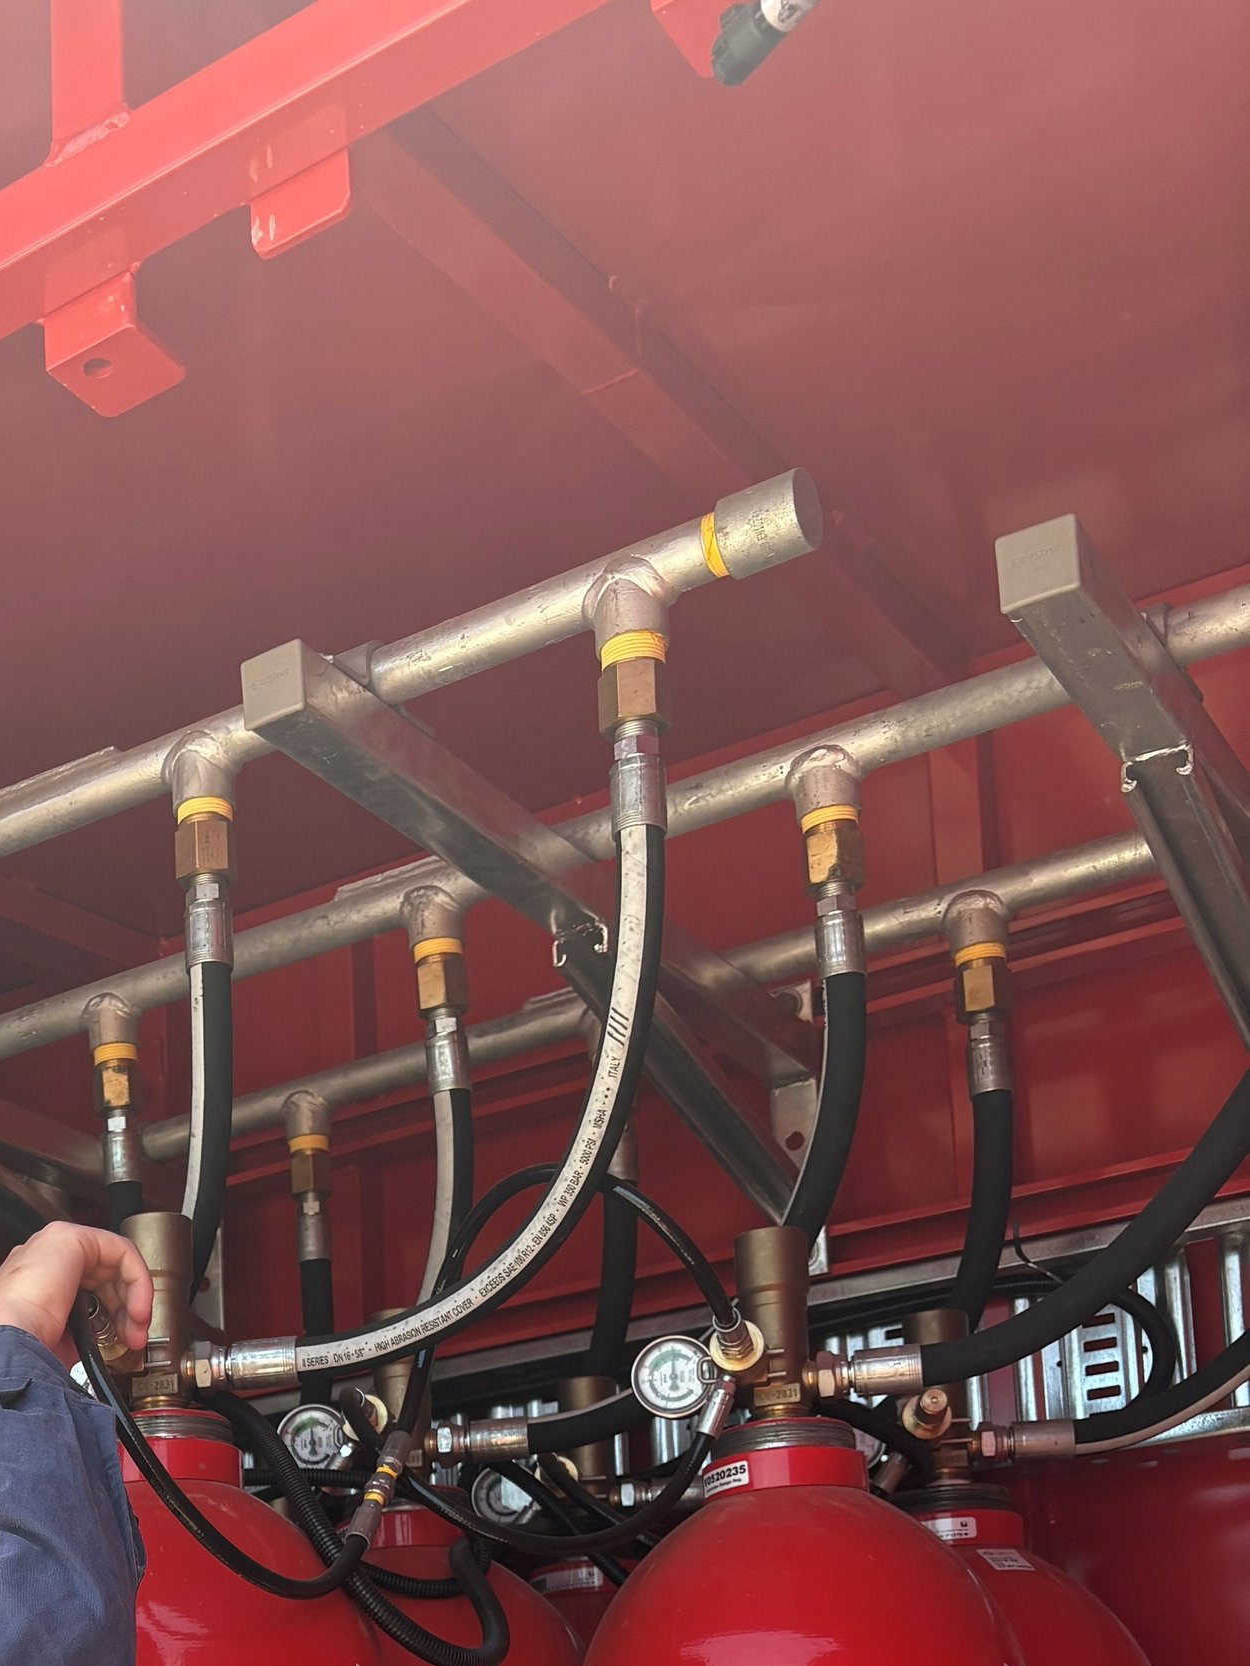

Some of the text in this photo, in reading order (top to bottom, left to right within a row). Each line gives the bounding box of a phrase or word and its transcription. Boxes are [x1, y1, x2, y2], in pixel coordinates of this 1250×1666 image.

[607, 1056, 622, 1079] ITALY
[306, 1355, 329, 1366] SERIES
[333, 1352, 344, 1363] DN
[374, 1340, 390, 1353] HIGH
[390, 1326, 422, 1346] ABRASION
[421, 1310, 453, 1335] RESISTANT
[453, 1297, 475, 1317] COVER
[478, 1272, 506, 1298] EXCEEDS
[503, 1262, 518, 1278] SAE
[522, 1244, 536, 1260] R12
[531, 1233, 544, 1246] EN
[557, 1194, 570, 1208] WP
[569, 1170, 585, 1186] BAR
[578, 1150, 592, 1166] 5000
[585, 1137, 598, 1152] PSI
